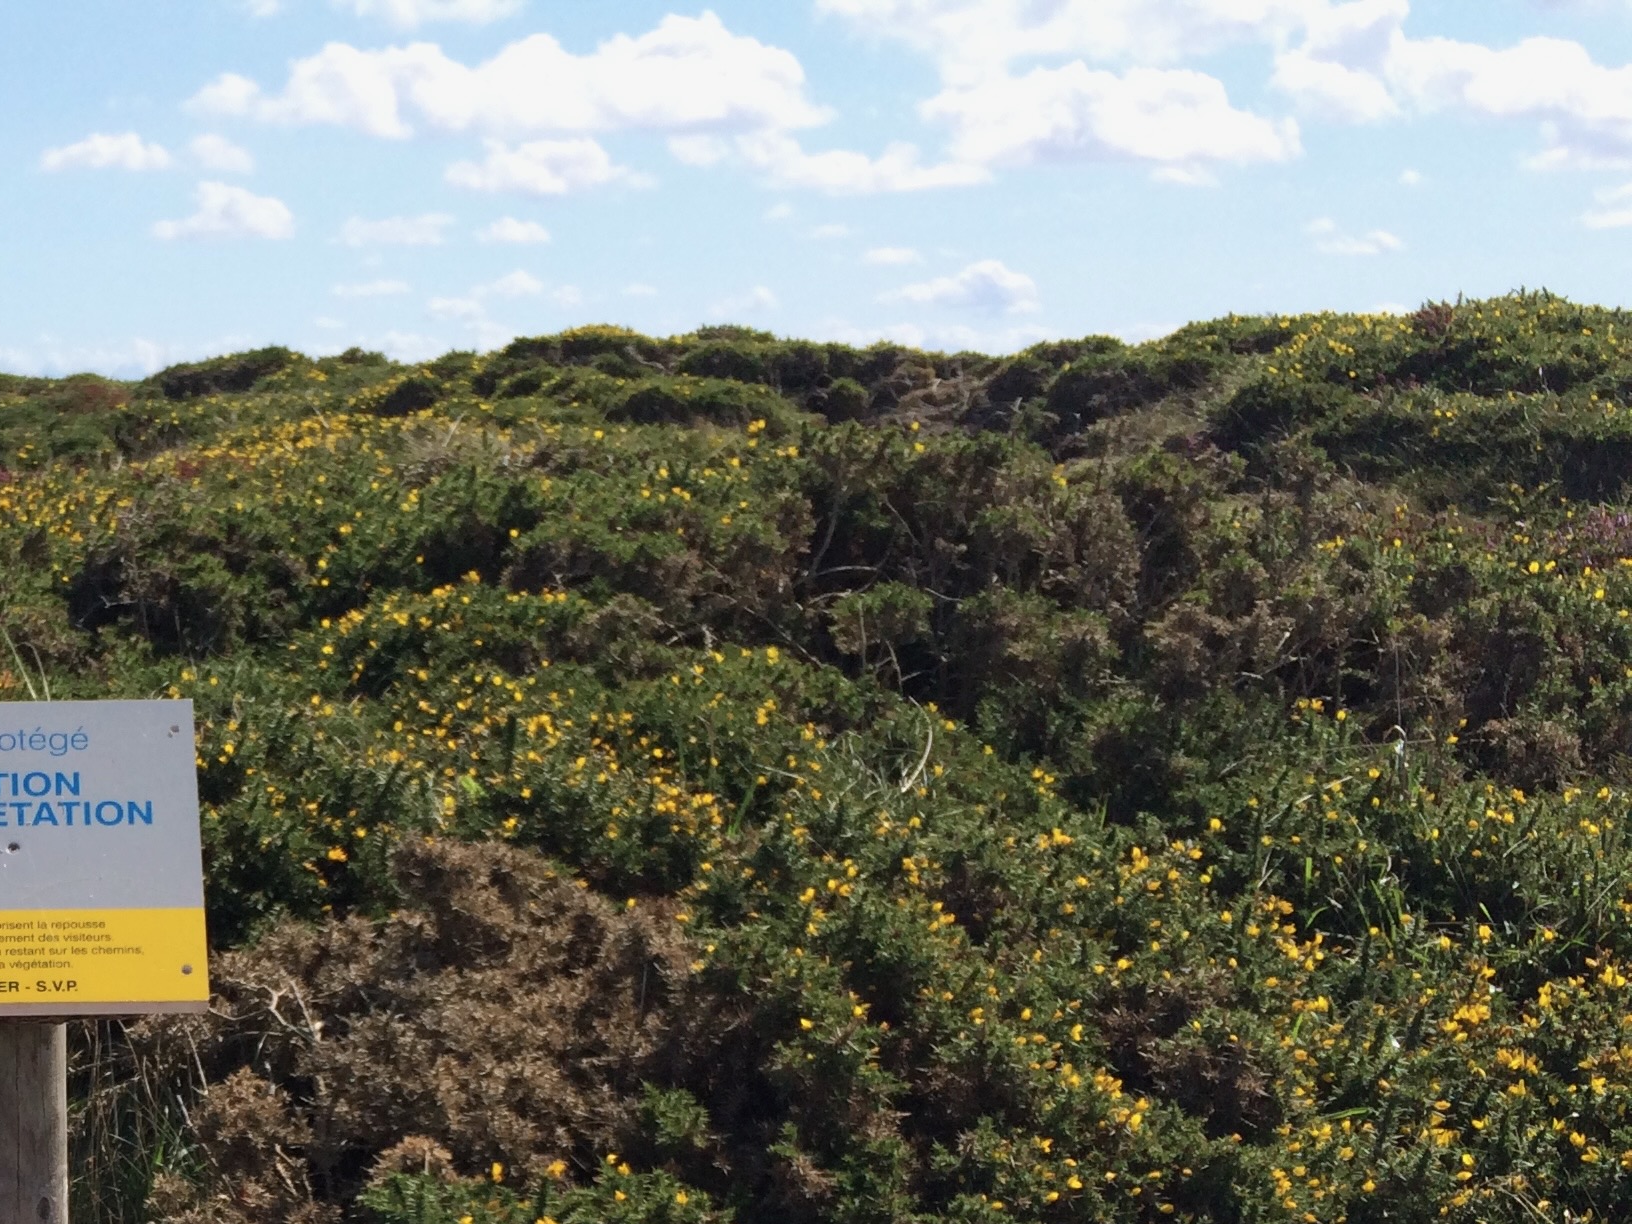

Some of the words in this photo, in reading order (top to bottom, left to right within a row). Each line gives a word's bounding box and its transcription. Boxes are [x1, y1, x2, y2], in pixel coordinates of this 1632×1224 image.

[37, 921, 47, 929] la
[51, 921, 106, 930] repousse
[38, 934, 59, 942] des
[5, 947, 45, 956] restant
[49, 948, 67, 956] sur
[71, 947, 88, 955] les
[36, 980, 78, 992] S.V.P.
